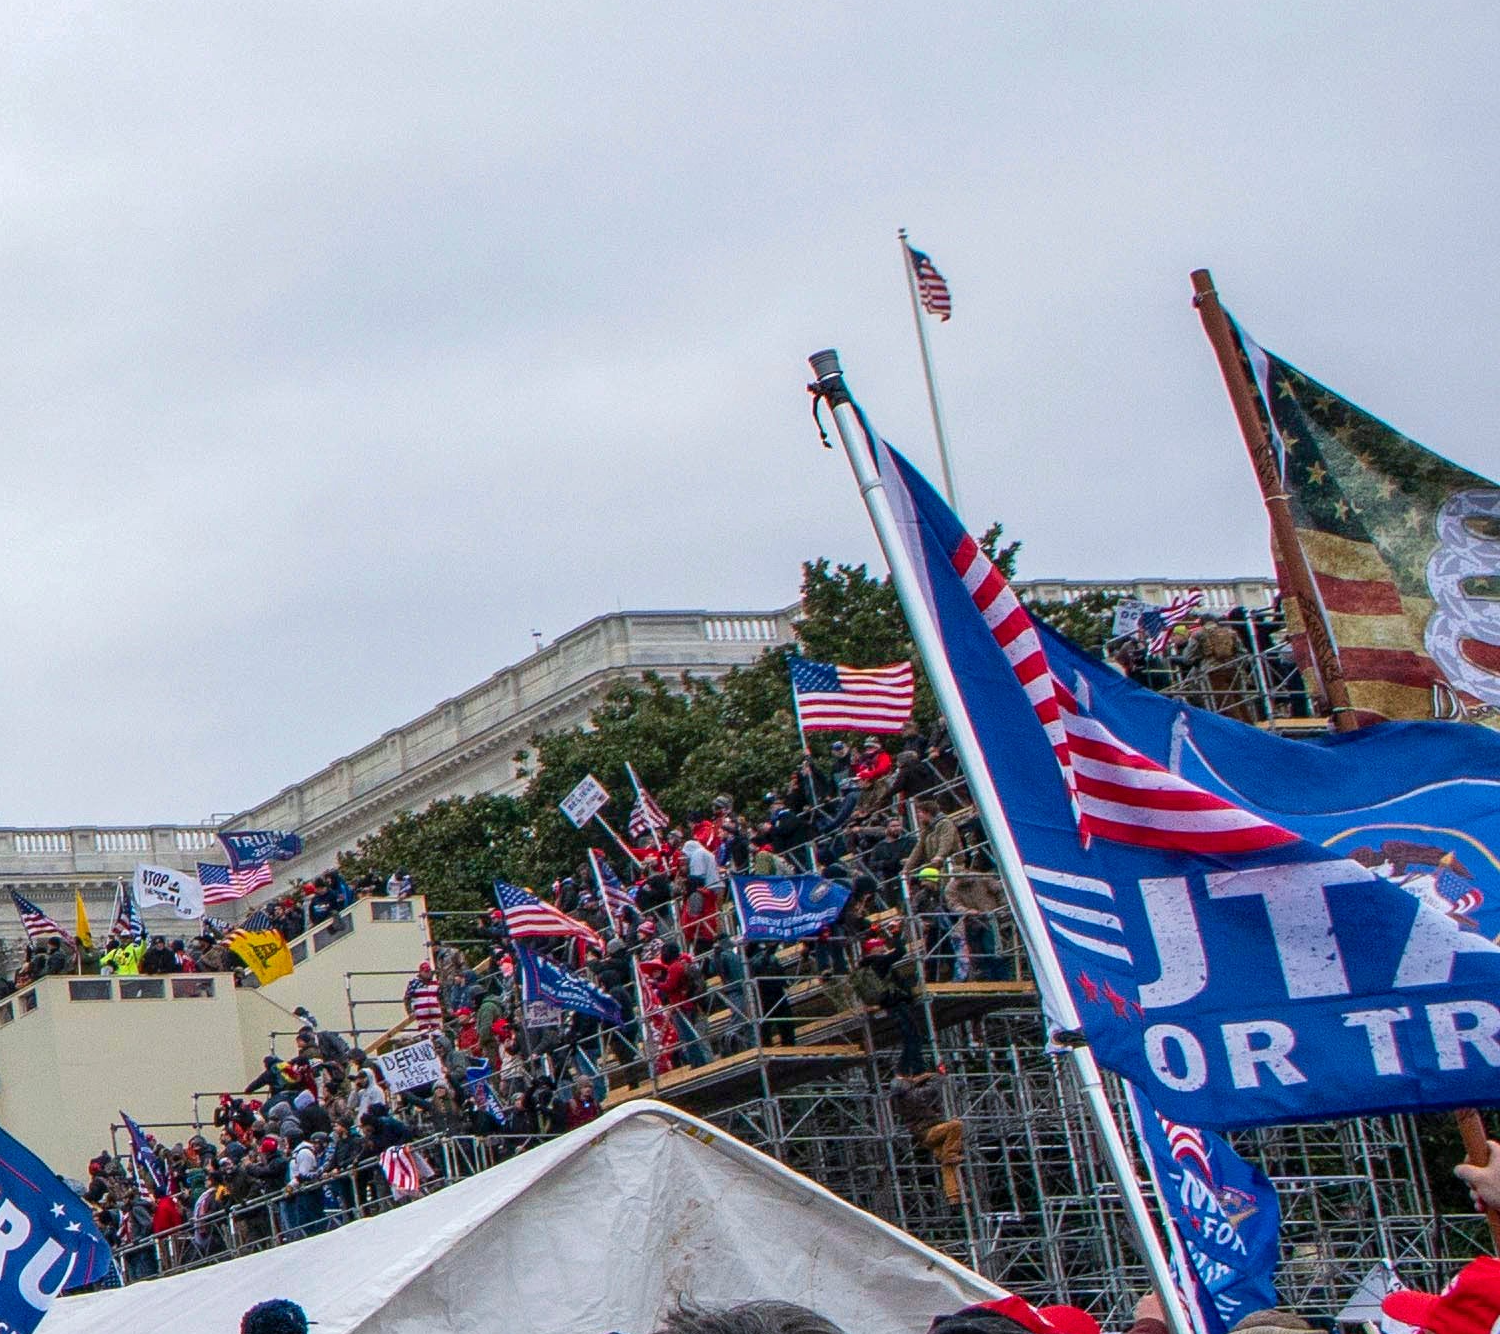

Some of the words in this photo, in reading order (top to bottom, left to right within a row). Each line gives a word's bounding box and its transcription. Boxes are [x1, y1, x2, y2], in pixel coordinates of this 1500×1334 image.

[143, 869, 169, 888] STOP
[383, 1044, 436, 1071] DEFUND
[395, 1072, 440, 1089] MEDIA
[398, 1065, 429, 1079] THE
